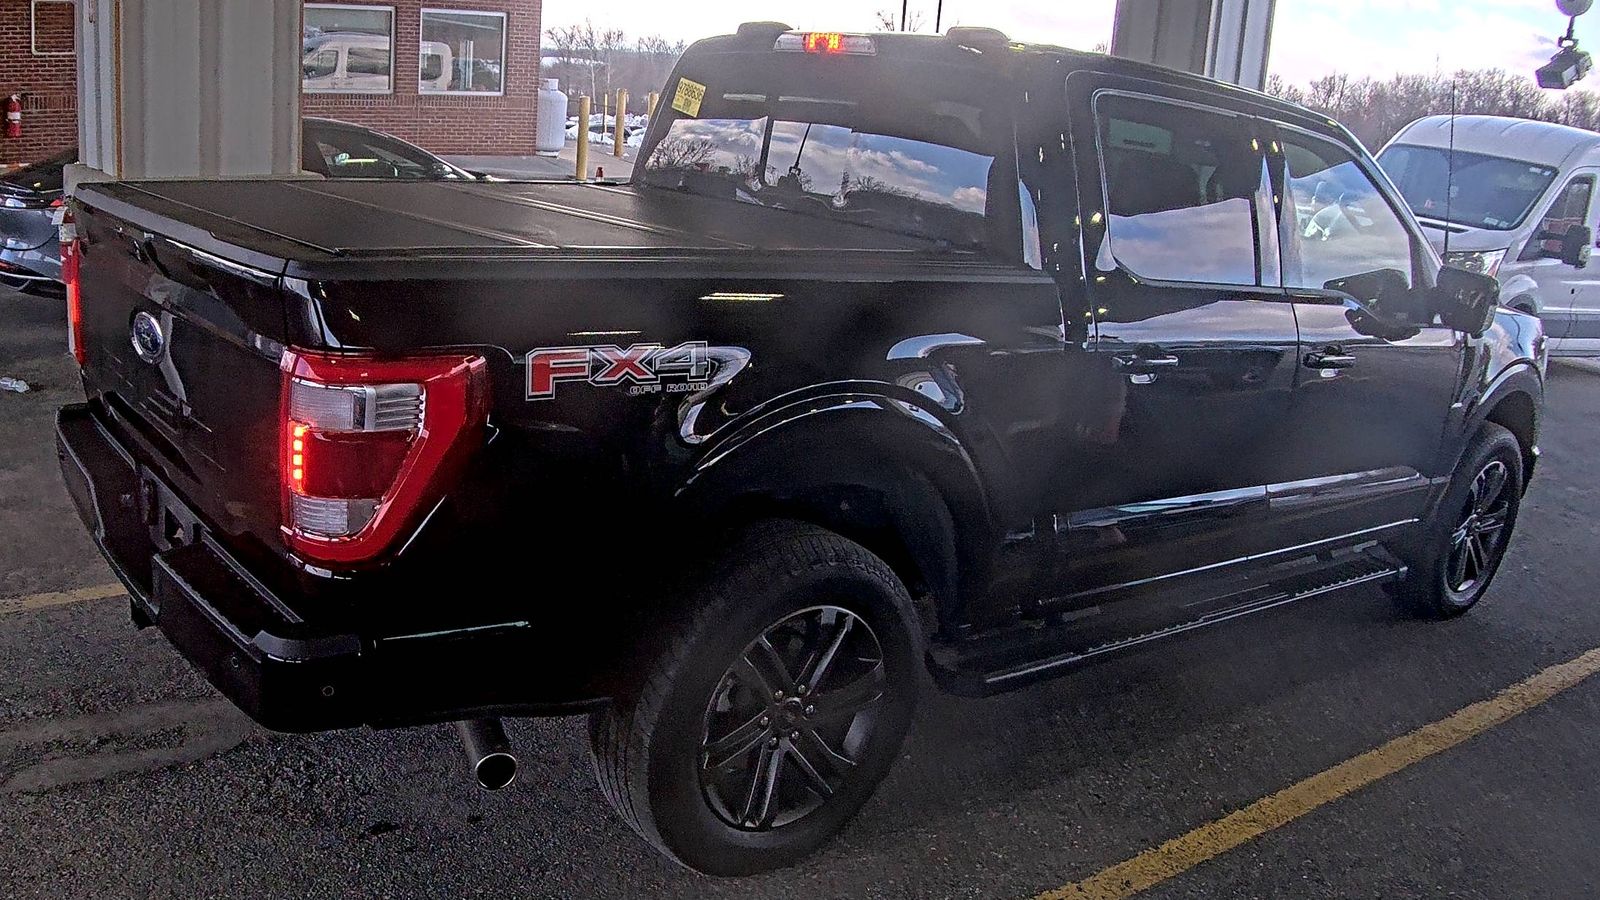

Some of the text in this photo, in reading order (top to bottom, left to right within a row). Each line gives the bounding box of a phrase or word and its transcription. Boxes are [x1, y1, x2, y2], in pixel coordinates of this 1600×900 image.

[526, 341, 710, 401] FX4
[629, 382, 708, 395] OFF ROAD
